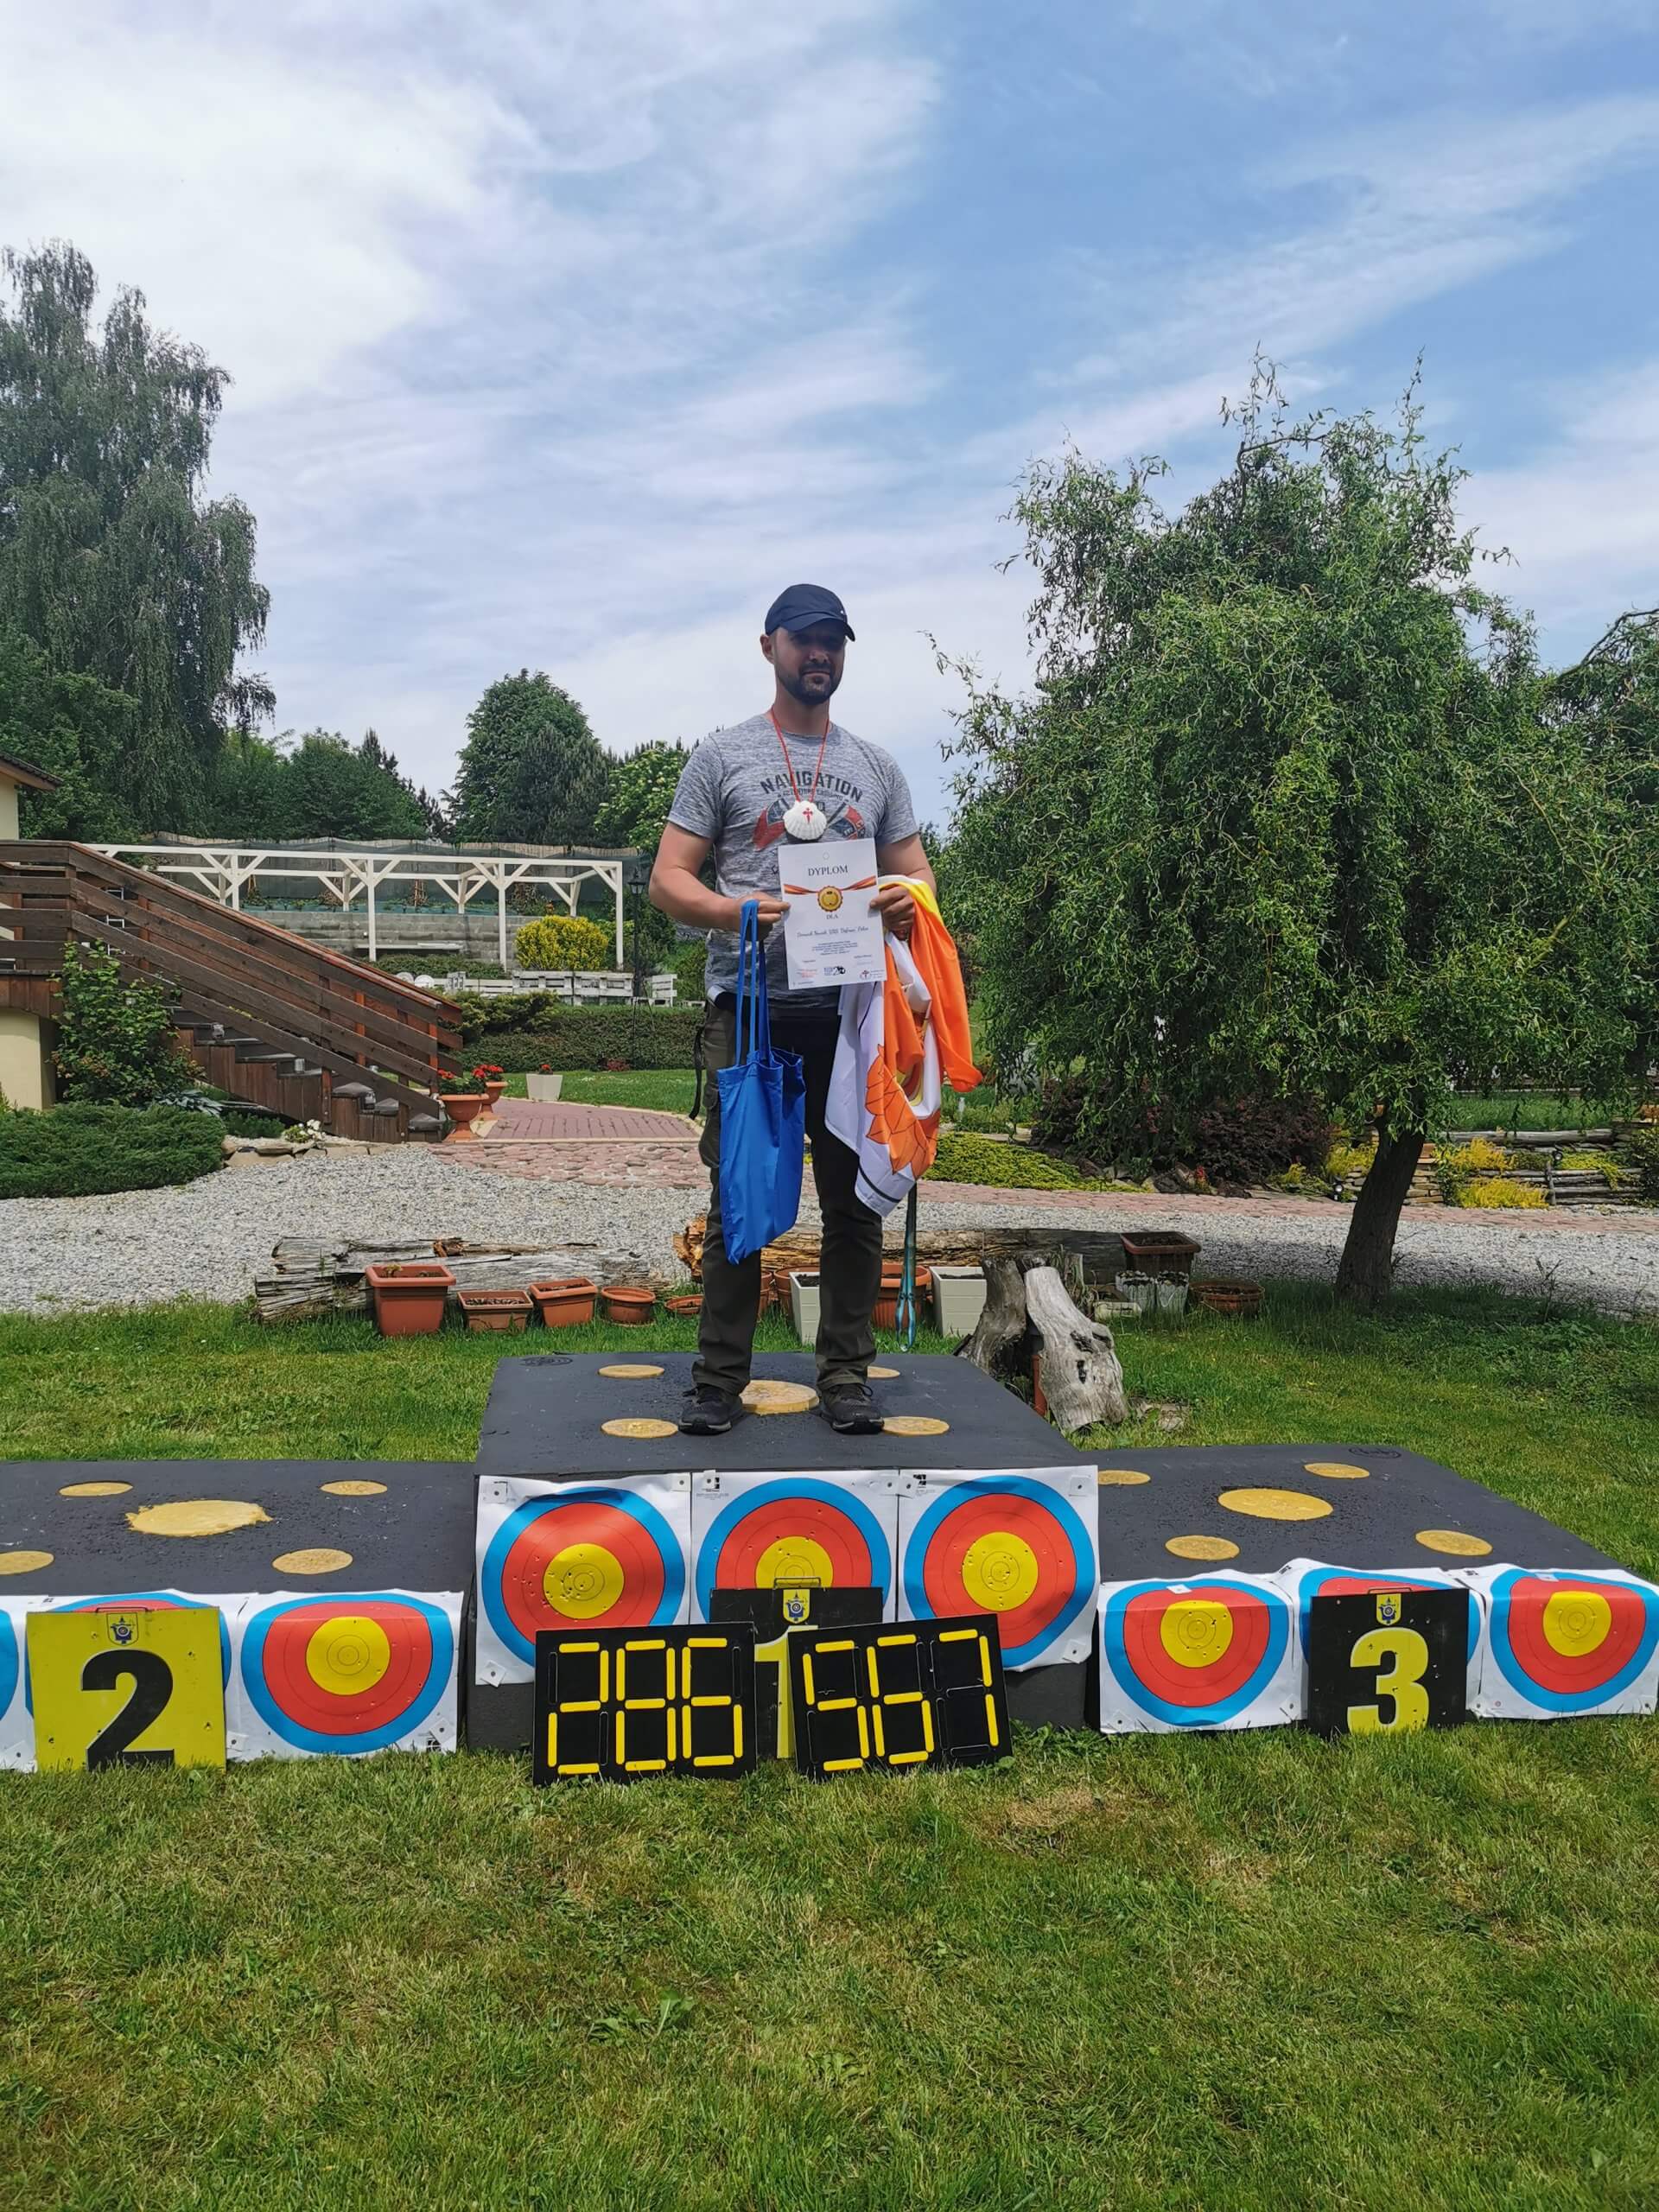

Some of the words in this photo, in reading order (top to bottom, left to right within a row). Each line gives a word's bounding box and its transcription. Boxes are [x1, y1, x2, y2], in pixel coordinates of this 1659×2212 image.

[760, 771, 863, 803] NAVIGATION
[808, 864, 849, 876] DYPLOM
[81, 1649, 174, 1771] 2
[547, 1637, 743, 1774] 286
[802, 1629, 999, 1771] 567
[1346, 1626, 1430, 1735] 3
